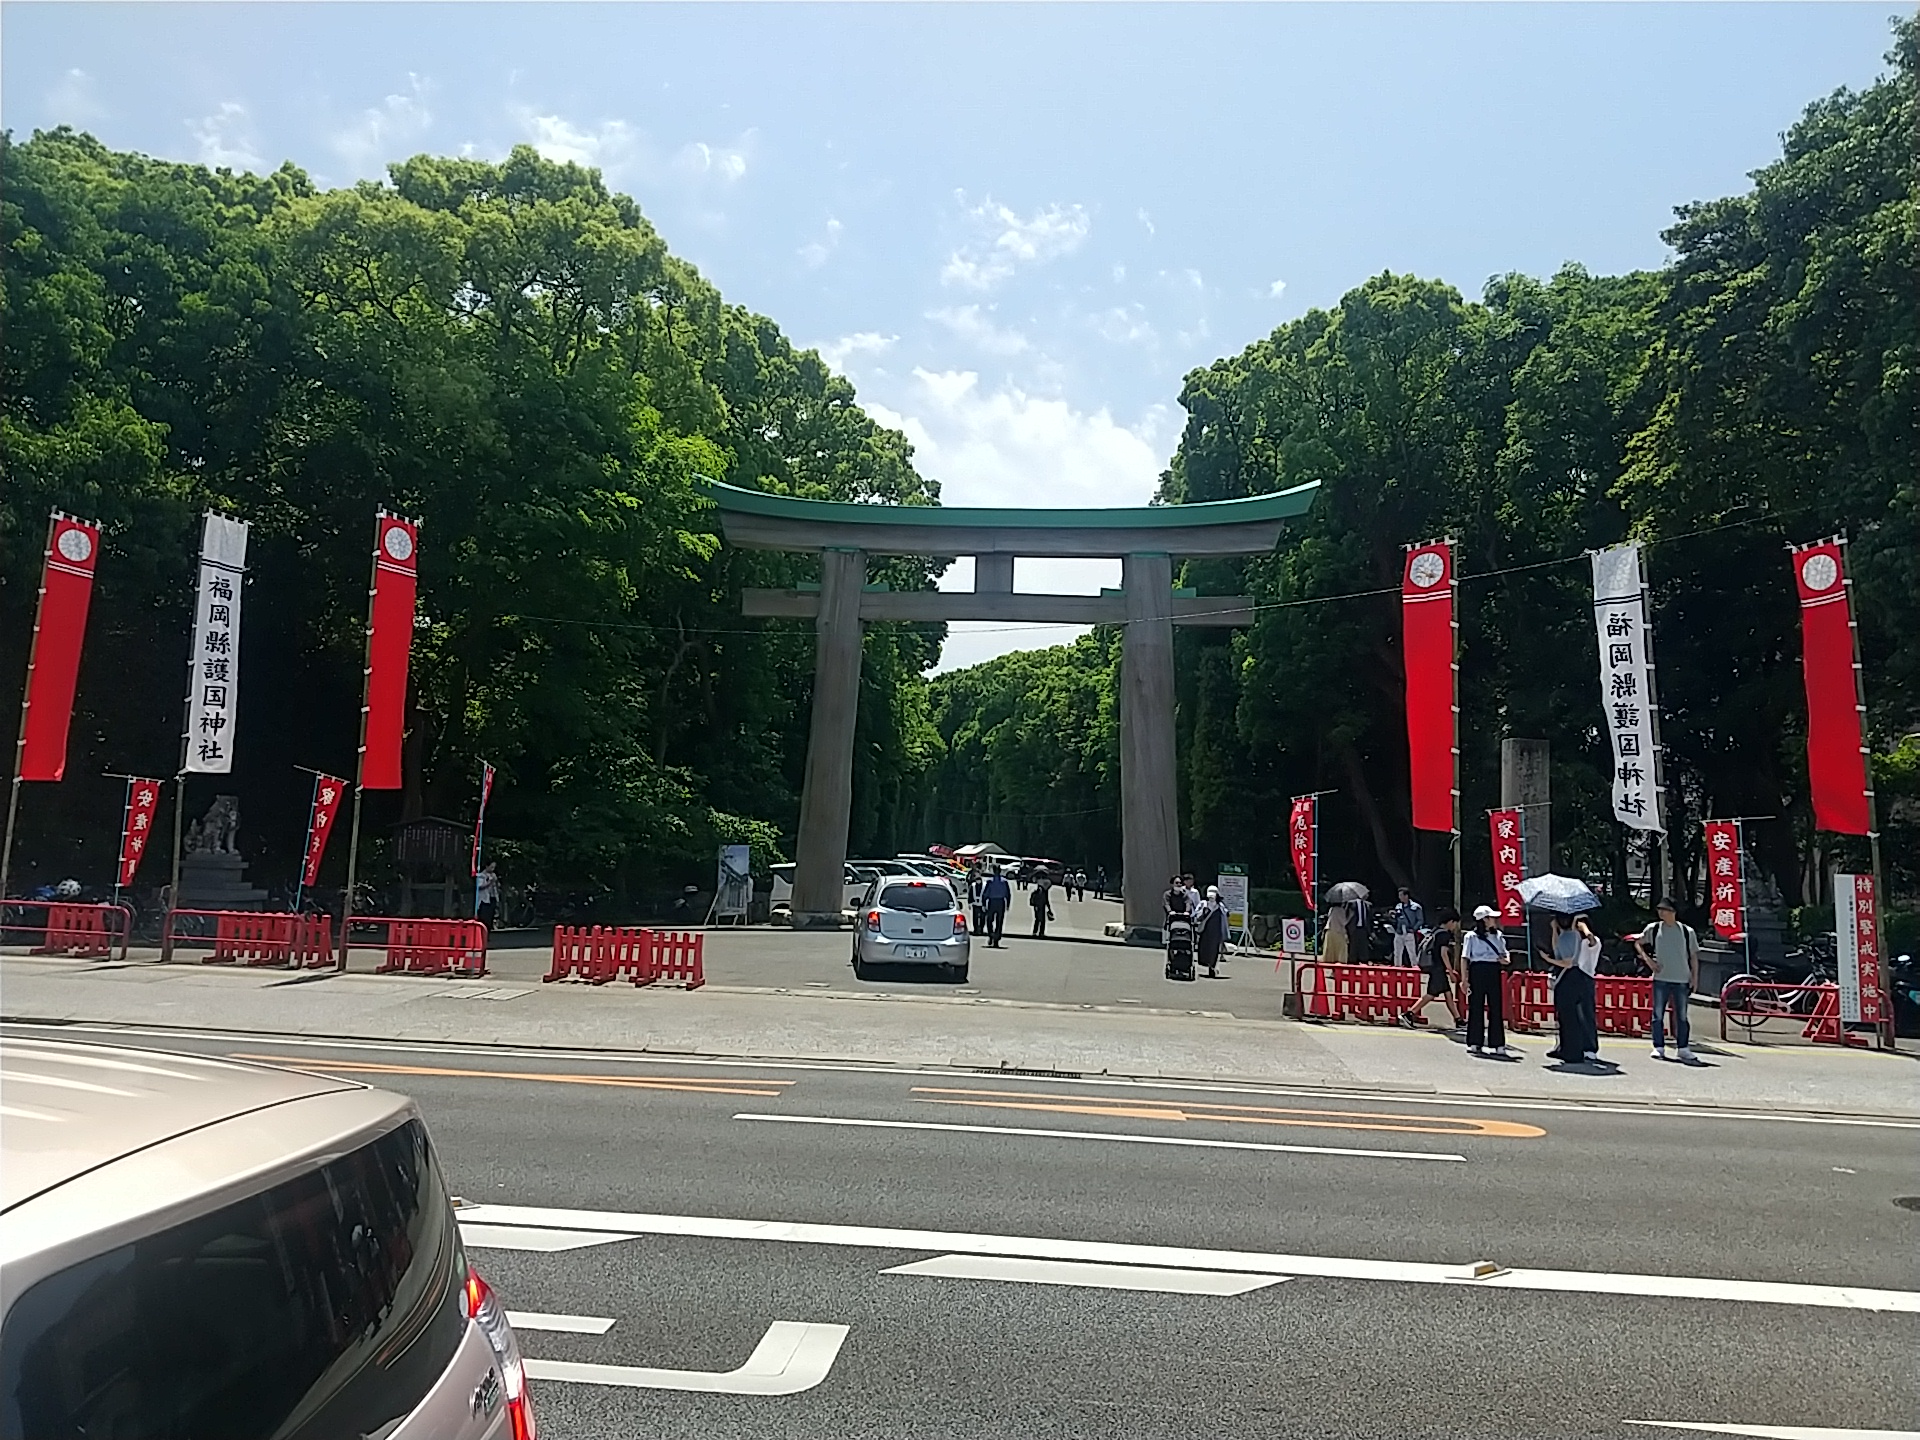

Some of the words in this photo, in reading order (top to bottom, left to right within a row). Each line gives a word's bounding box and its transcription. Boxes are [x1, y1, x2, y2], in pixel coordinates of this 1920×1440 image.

[197, 576, 235, 761] 福岡縣護国神社
[1497, 819, 1522, 917] 家内安全
[1711, 831, 1736, 928] 安産祈願
[1856, 877, 1878, 1020] 特別警戒実施中
